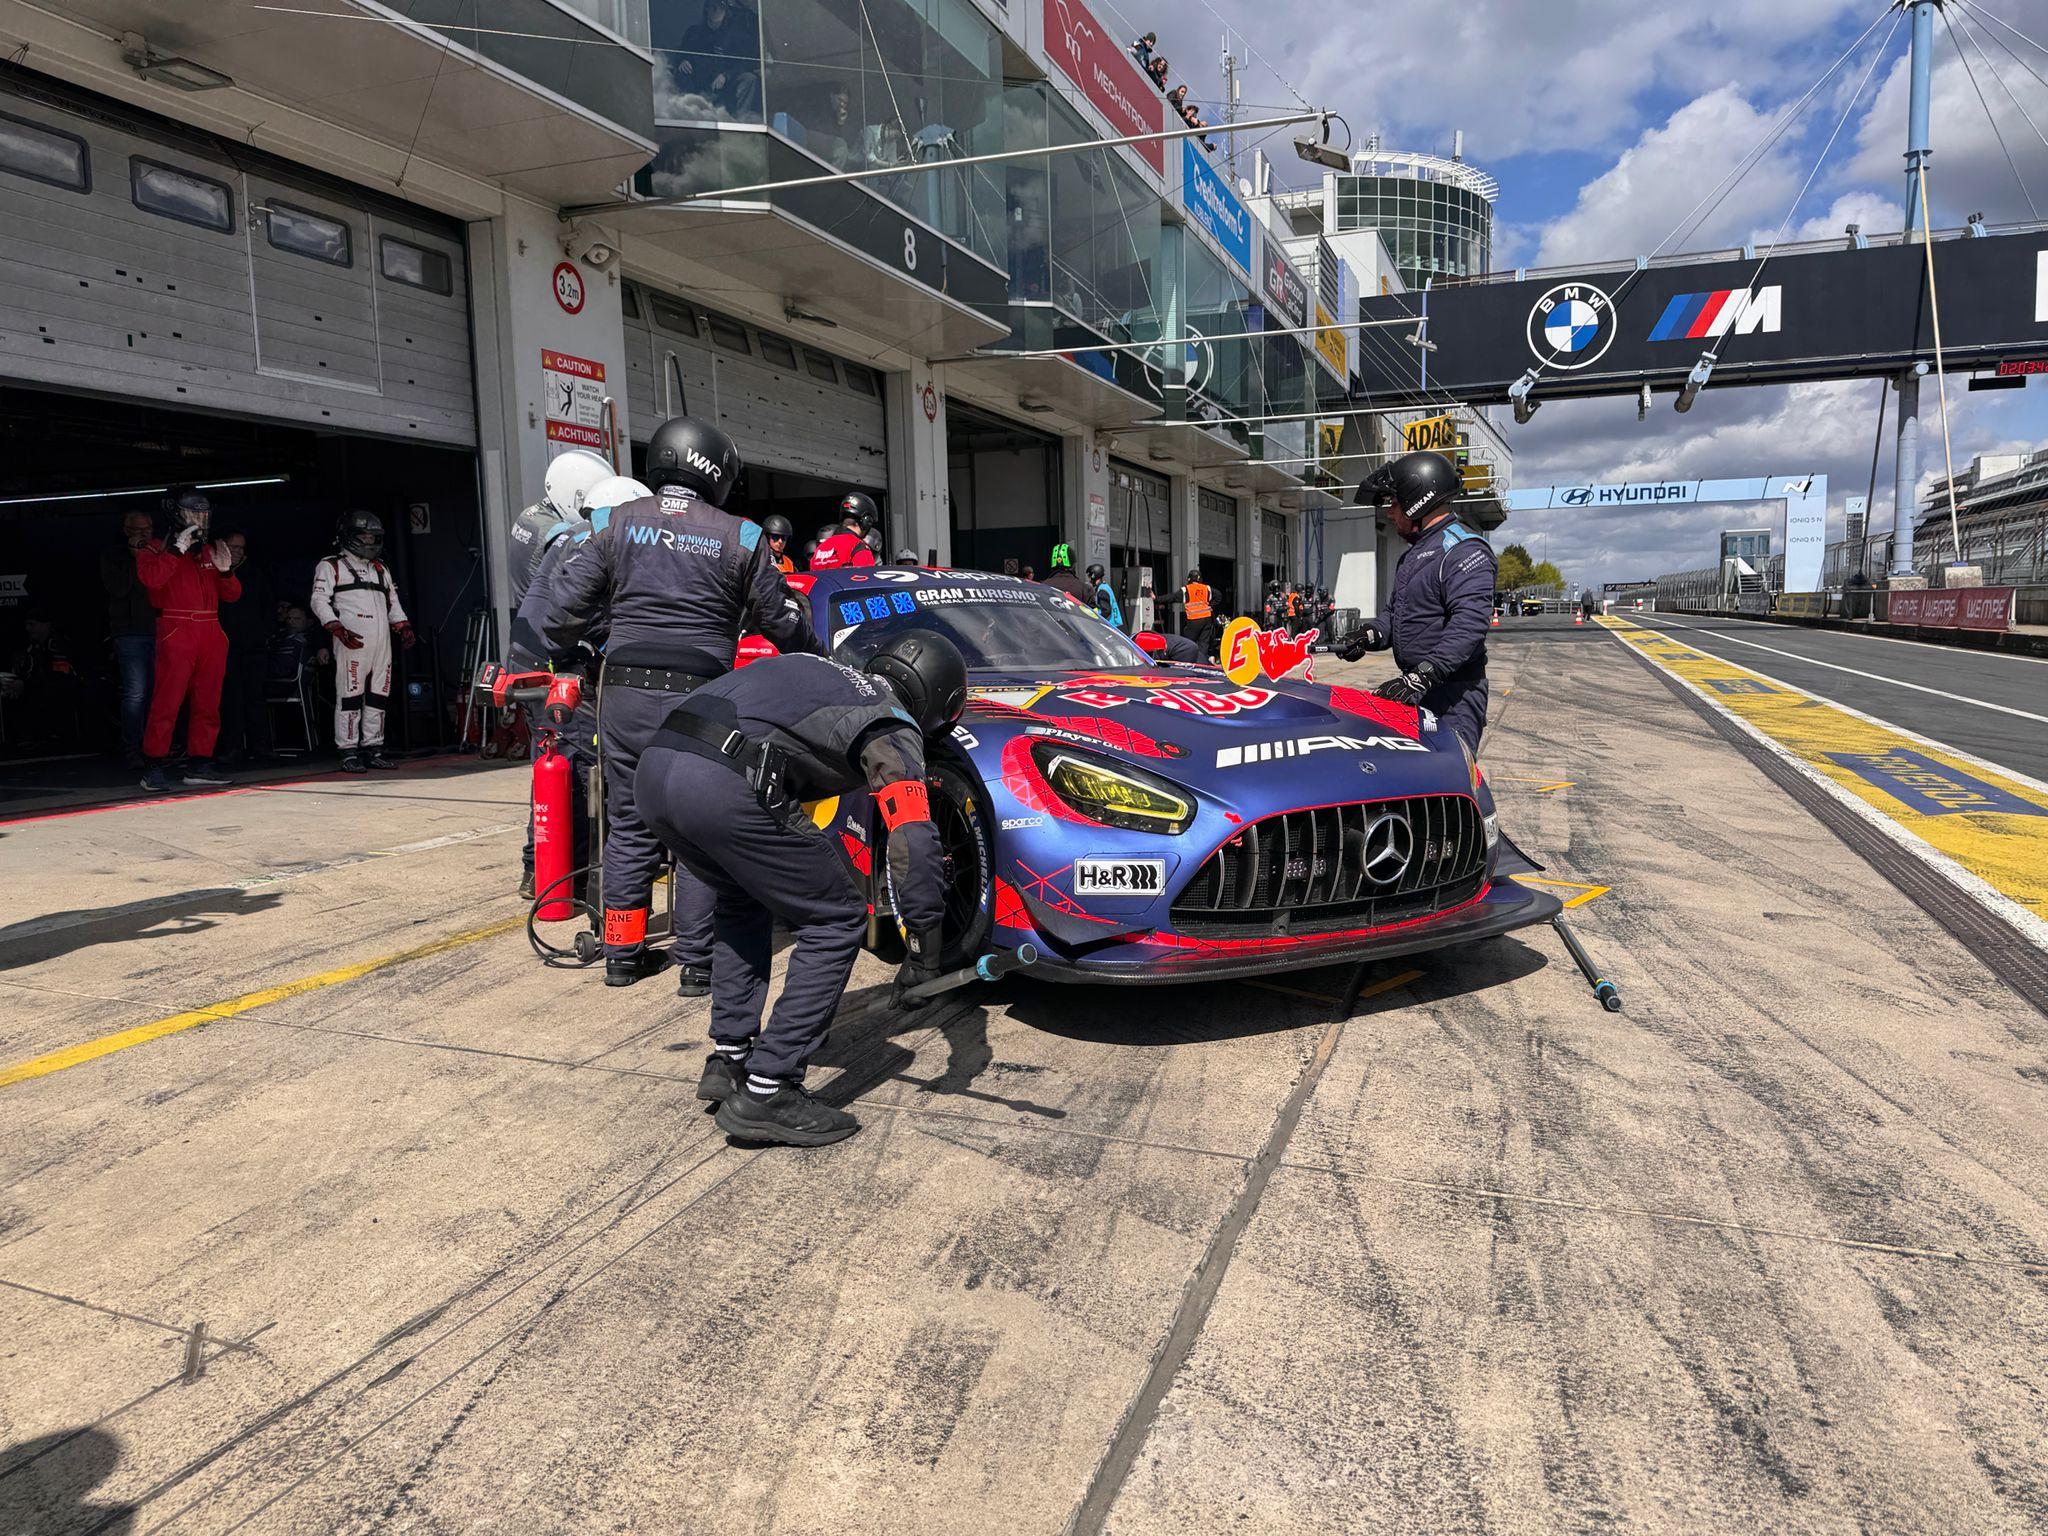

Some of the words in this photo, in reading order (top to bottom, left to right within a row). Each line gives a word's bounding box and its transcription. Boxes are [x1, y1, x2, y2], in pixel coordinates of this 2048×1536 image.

[1093, 62, 1157, 149] MECHATRON
[1193, 163, 1238, 241] Creditreform
[904, 227, 917, 271] 8
[1539, 286, 1605, 315] BMW
[556, 357, 592, 375] CAUTION
[577, 391, 591, 400] YOUR
[591, 394, 605, 403] HEA
[581, 383, 600, 394] WATCH
[557, 426, 600, 444] ACHTUNG
[1408, 418, 1453, 451] ADAC
[1599, 485, 1686, 501] HYUNDAI
[661, 500, 688, 510] OMP
[1405, 490, 1436, 517] BERKAN
[677, 534, 722, 549] WINWARD
[677, 542, 721, 558] RACING
[915, 588, 964, 602] GRAN
[967, 588, 1036, 601] TURISMO
[1892, 599, 1919, 616] WEMPE
[1925, 599, 1956, 617] WEMPE
[1966, 599, 2007, 619] WEMPE
[1299, 735, 1431, 755] AMG
[975, 826, 989, 906] MICHELIN
[1079, 865, 1131, 889] H&R
